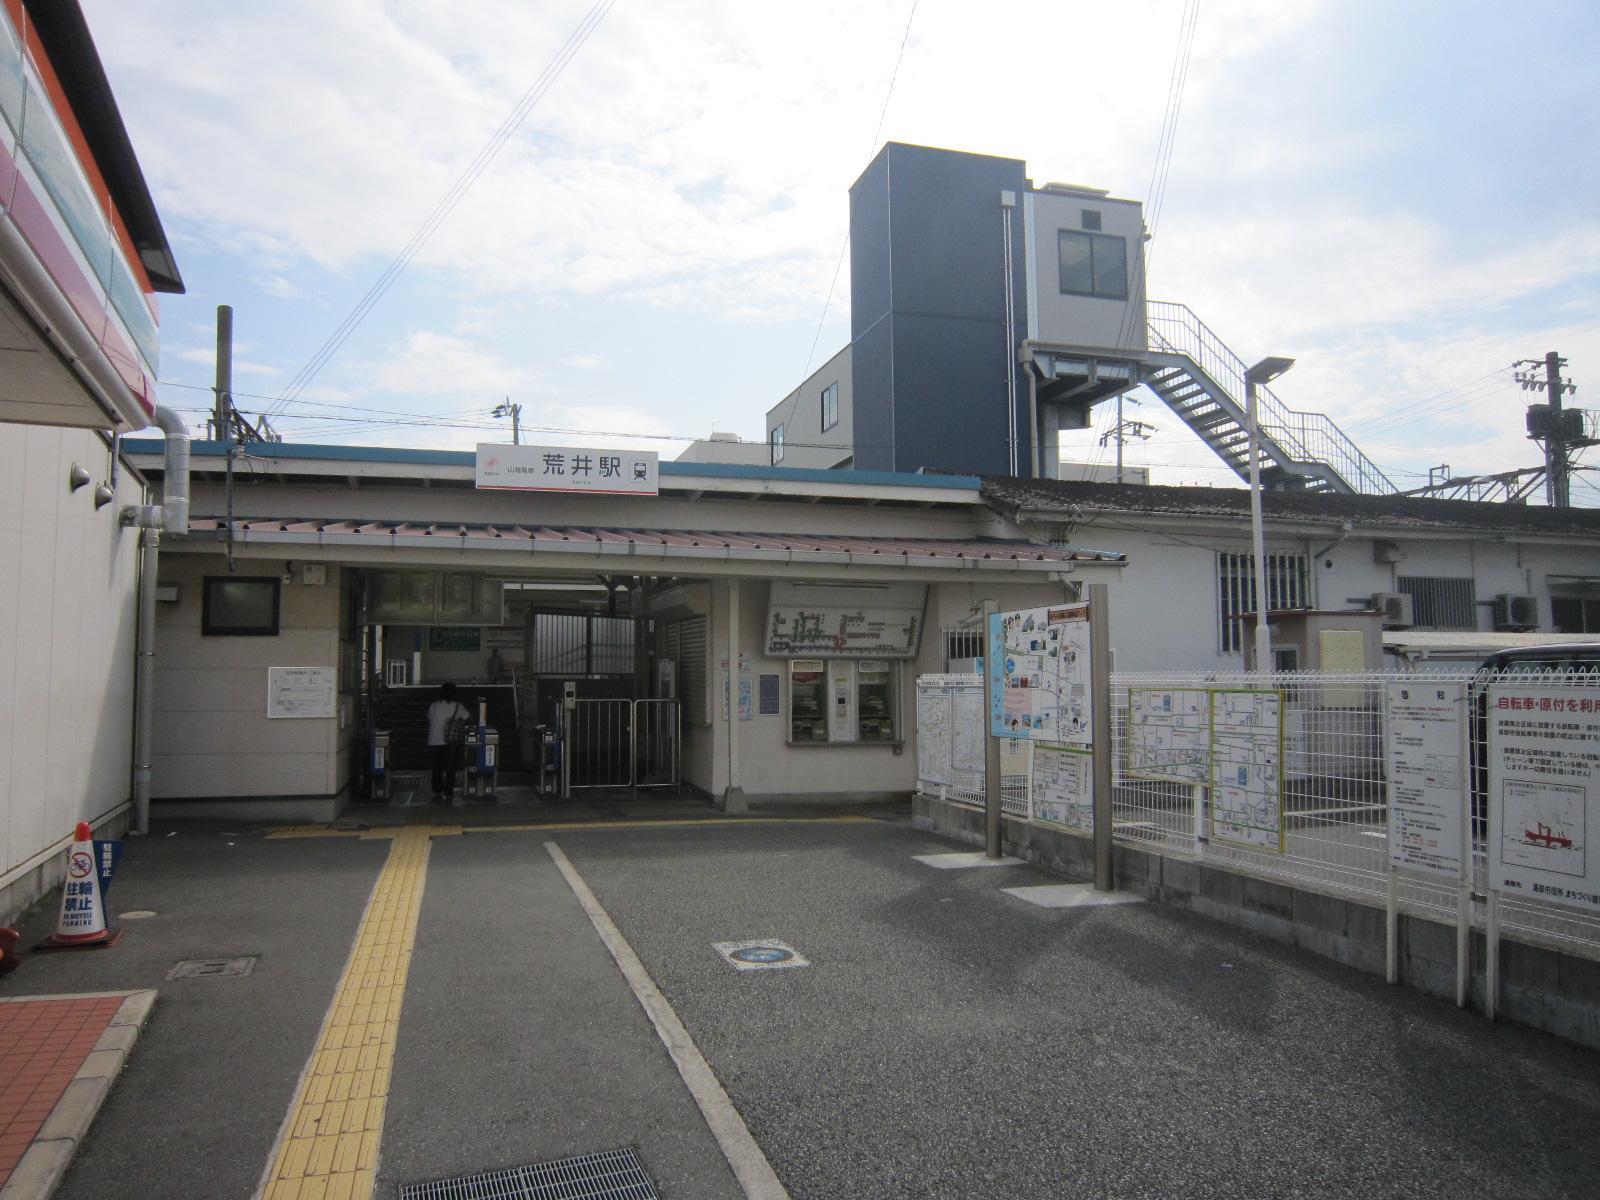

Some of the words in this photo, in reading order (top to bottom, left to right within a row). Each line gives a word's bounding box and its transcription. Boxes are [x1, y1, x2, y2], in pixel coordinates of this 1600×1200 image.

[543, 453, 621, 478] 荒井駅
[67, 882, 93, 895] 駐輪
[65, 897, 92, 911] 禁止
[62, 919, 92, 927] PARKING
